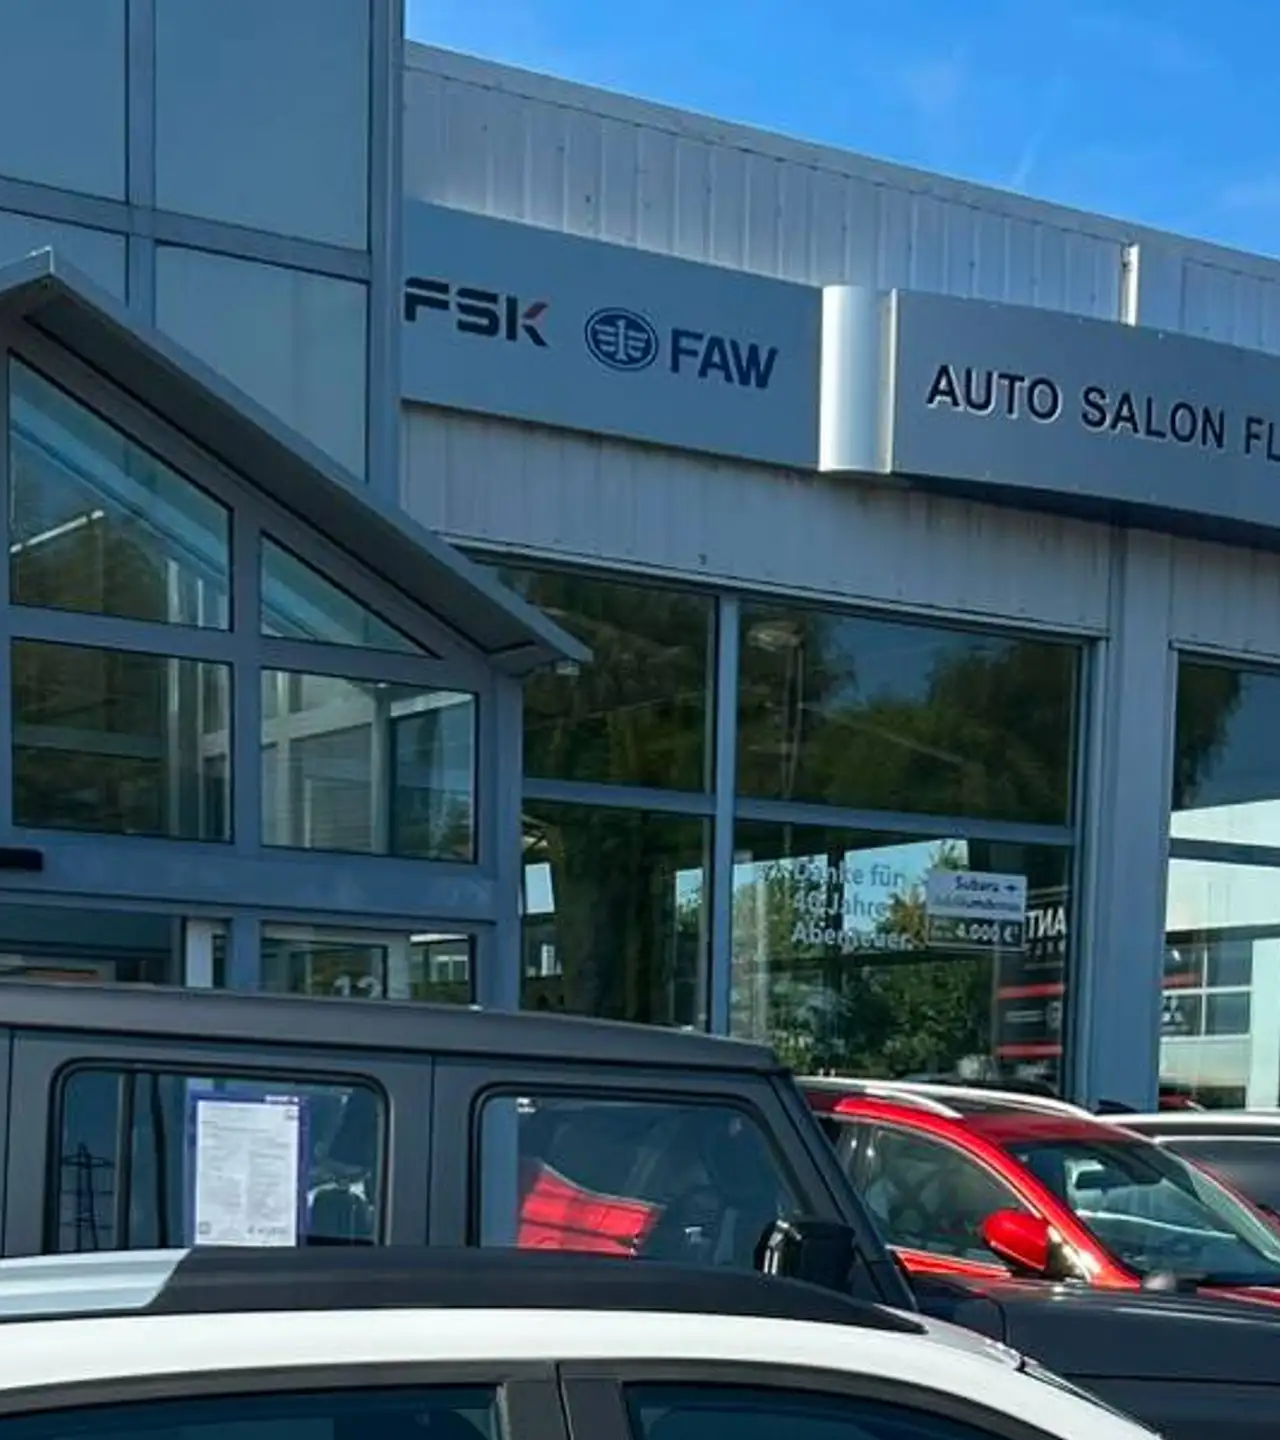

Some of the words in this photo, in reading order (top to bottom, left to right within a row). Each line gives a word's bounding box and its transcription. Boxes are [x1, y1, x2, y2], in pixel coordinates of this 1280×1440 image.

[670, 328, 778, 389] FAW
[926, 364, 1061, 422] AUTO
[1081, 386, 1225, 448] SALON
[870, 863, 905, 887] für
